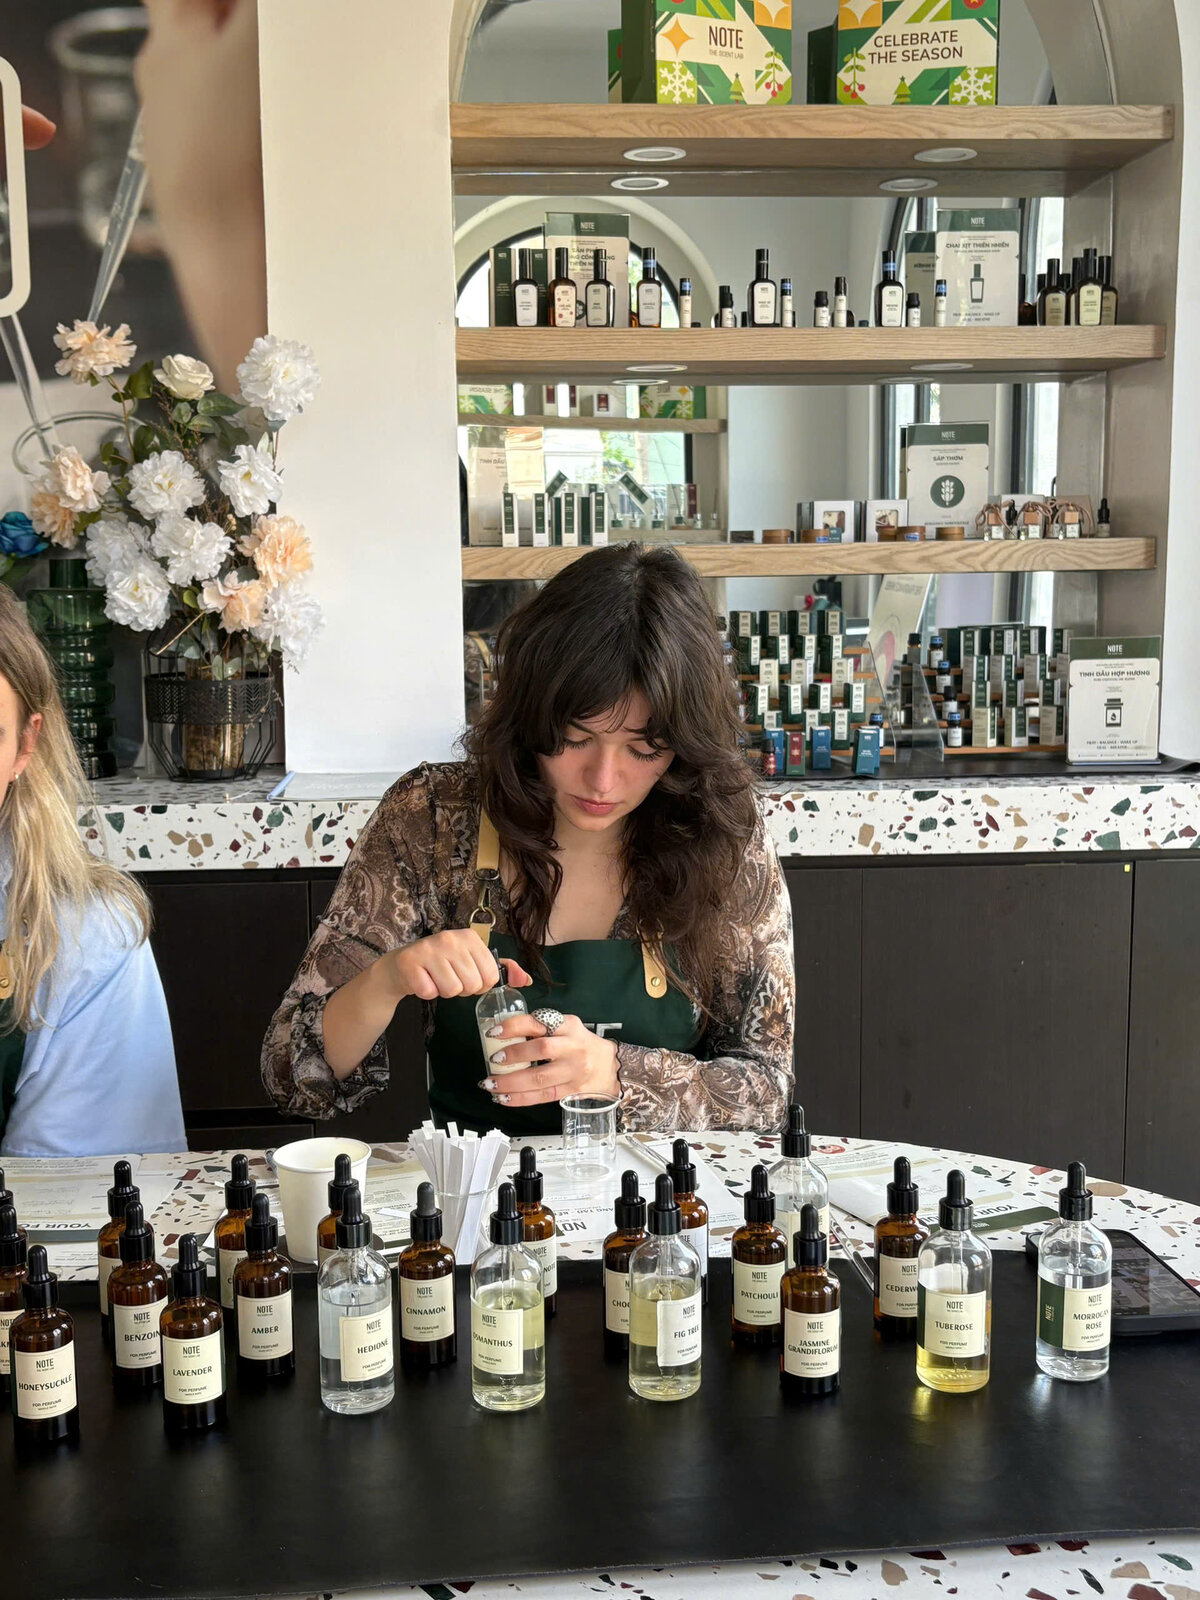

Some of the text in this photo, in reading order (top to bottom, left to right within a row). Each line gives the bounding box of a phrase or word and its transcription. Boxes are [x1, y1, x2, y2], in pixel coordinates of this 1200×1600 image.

[709, 25, 743, 49] NOTE
[874, 30, 958, 48] CELEBRATE
[868, 46, 963, 65] THE SEASON
[971, 217, 985, 225] NOTE
[1107, 645, 1123, 653] NOTE
[562, 1221, 587, 1232] NO
[901, 1265, 917, 1273] NOTE
[751, 1271, 767, 1280] NOTE
[416, 1287, 432, 1295] NOTE
[886, 1284, 917, 1293] CEDERW
[741, 1290, 778, 1300] PATCHOULI
[1088, 1294, 1102, 1303] NOTE
[612, 1300, 629, 1308] CHOC
[946, 1300, 963, 1309] NOTE
[256, 1305, 273, 1314] NOTE
[406, 1305, 446, 1316] CINNAMON
[682, 1304, 695, 1316] NOTE
[133, 1311, 150, 1321] NOTE
[481, 1314, 497, 1325] NOTE
[251, 1325, 279, 1334] AMBER
[366, 1319, 381, 1331] NOTE
[807, 1321, 823, 1330] NOTE
[935, 1321, 973, 1331] TUBEROSE
[1085, 1321, 1102, 1330] ROSE
[124, 1330, 161, 1342] BENZOIN
[674, 1325, 700, 1339] FIG TREE
[472, 1331, 513, 1348] OSMANTHUS
[799, 1339, 829, 1348] JASMINE
[182, 1345, 200, 1355] NOTE
[357, 1338, 389, 1354] HEDIONE
[788, 1344, 838, 1355] GRANDIFLORUM
[36, 1358, 54, 1369] NOTE
[173, 1366, 213, 1377] LAVENDER
[19, 1373, 73, 1392] HONEYSUCKLE
[41, 1399, 62, 1407] PERFUME
